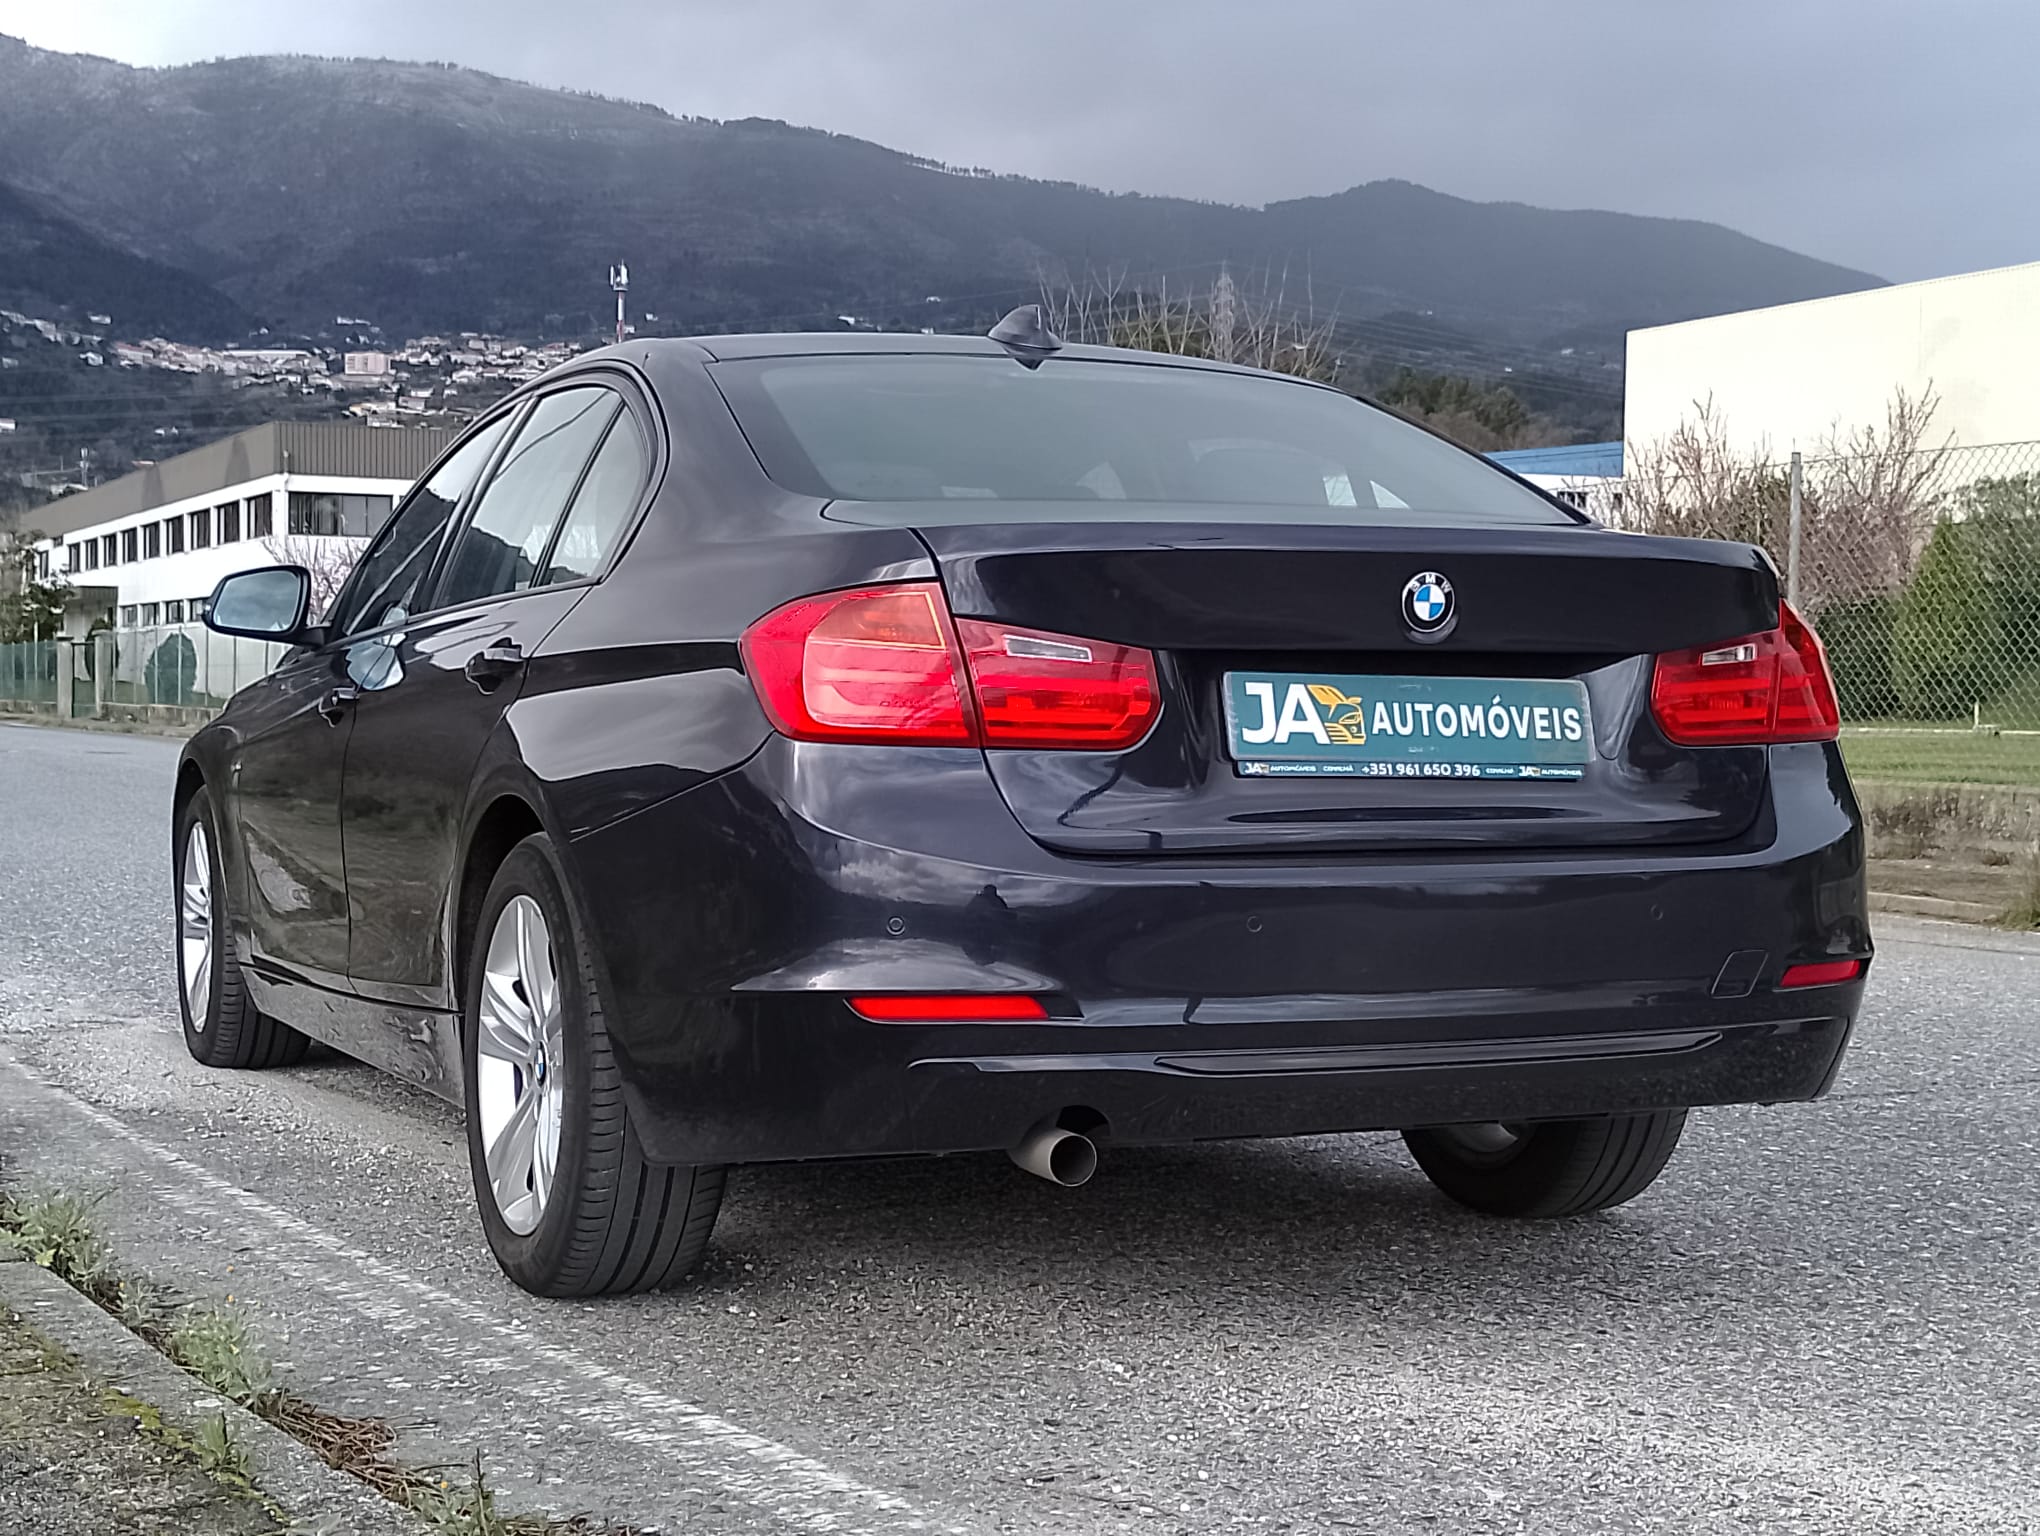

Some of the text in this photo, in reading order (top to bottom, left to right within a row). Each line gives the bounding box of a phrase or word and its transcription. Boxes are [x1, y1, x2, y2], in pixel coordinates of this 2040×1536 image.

[1409, 573, 1452, 594] BMW
[1241, 680, 1583, 745] JA AUTOMÓVEIS
[1361, 763, 1393, 775] +351
[1395, 763, 1420, 775] 961
[1423, 764, 1451, 775] 650
[1454, 764, 1481, 776] 396
